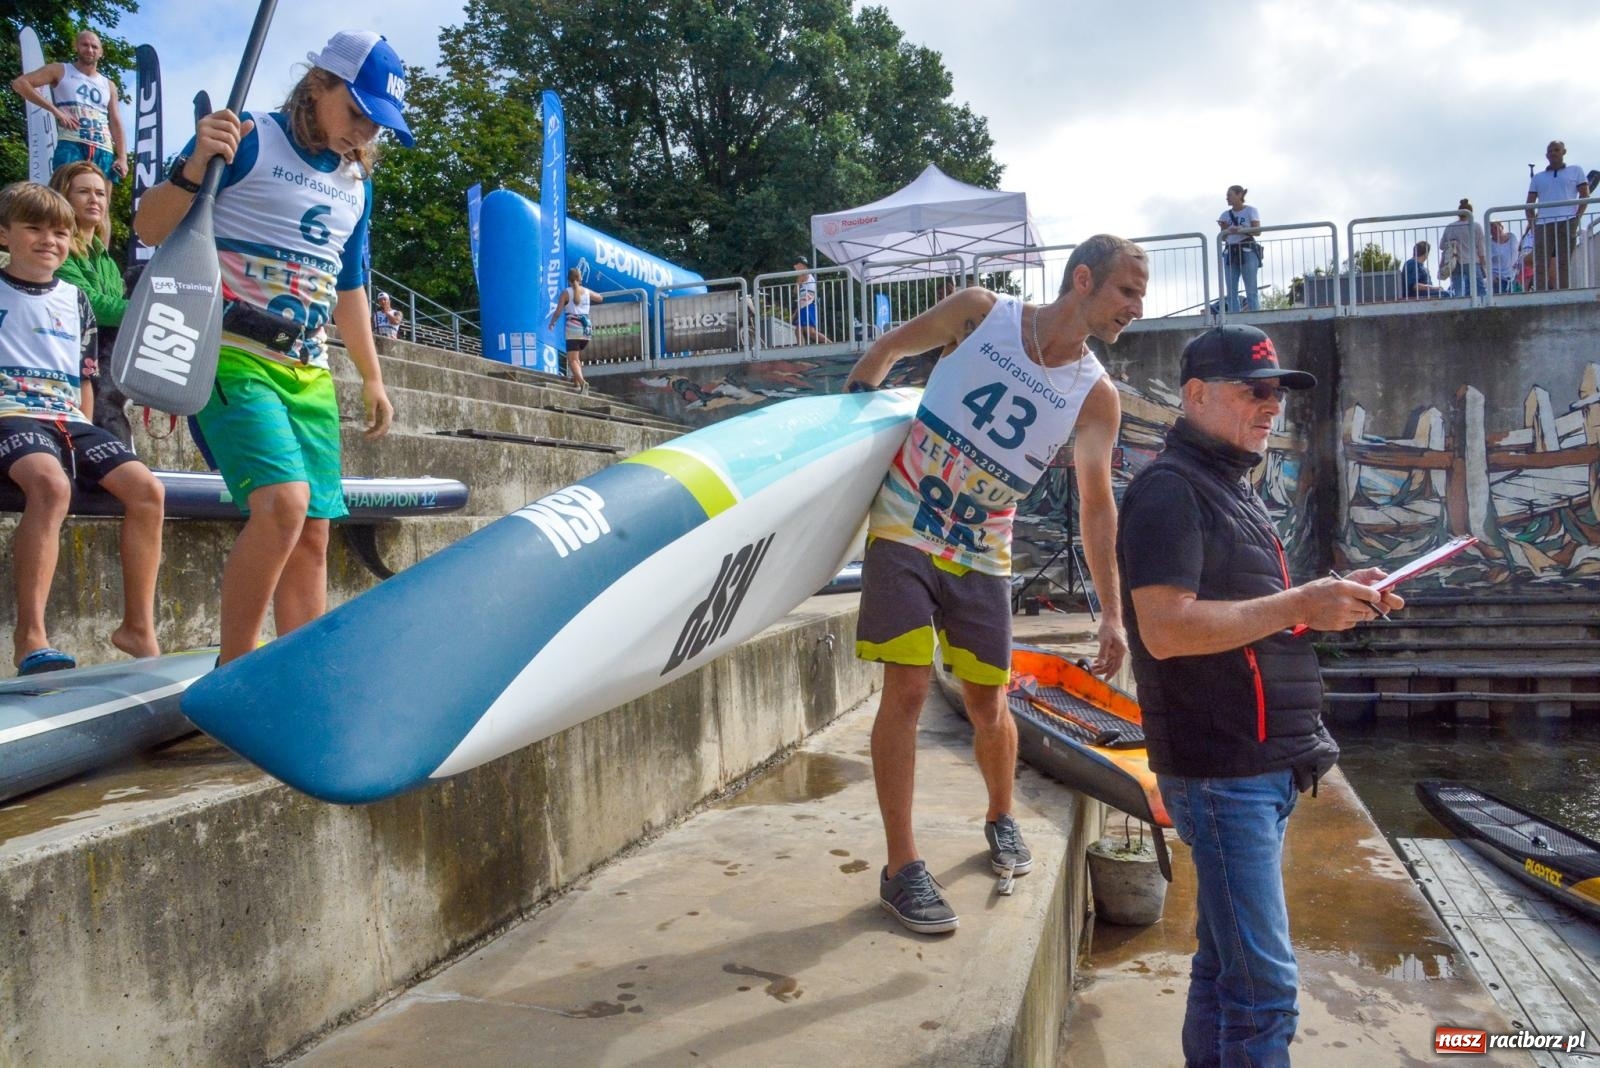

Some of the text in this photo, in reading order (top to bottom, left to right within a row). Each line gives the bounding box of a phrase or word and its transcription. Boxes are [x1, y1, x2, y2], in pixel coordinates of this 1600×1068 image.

[76, 84, 102, 104] 40
[272, 165, 358, 206] #odrasupcup
[300, 204, 332, 246] 6
[594, 237, 673, 290] DECATHLON
[177, 281, 213, 293] Training
[673, 312, 727, 330] intex
[135, 302, 200, 386] NSP
[979, 342, 1067, 410] #odrasupcup
[961, 381, 1038, 450] 43
[86, 441, 132, 463] GIVE
[347, 490, 418, 508] HAMPION
[511, 485, 611, 558] NSP
[660, 532, 776, 676] NSP
